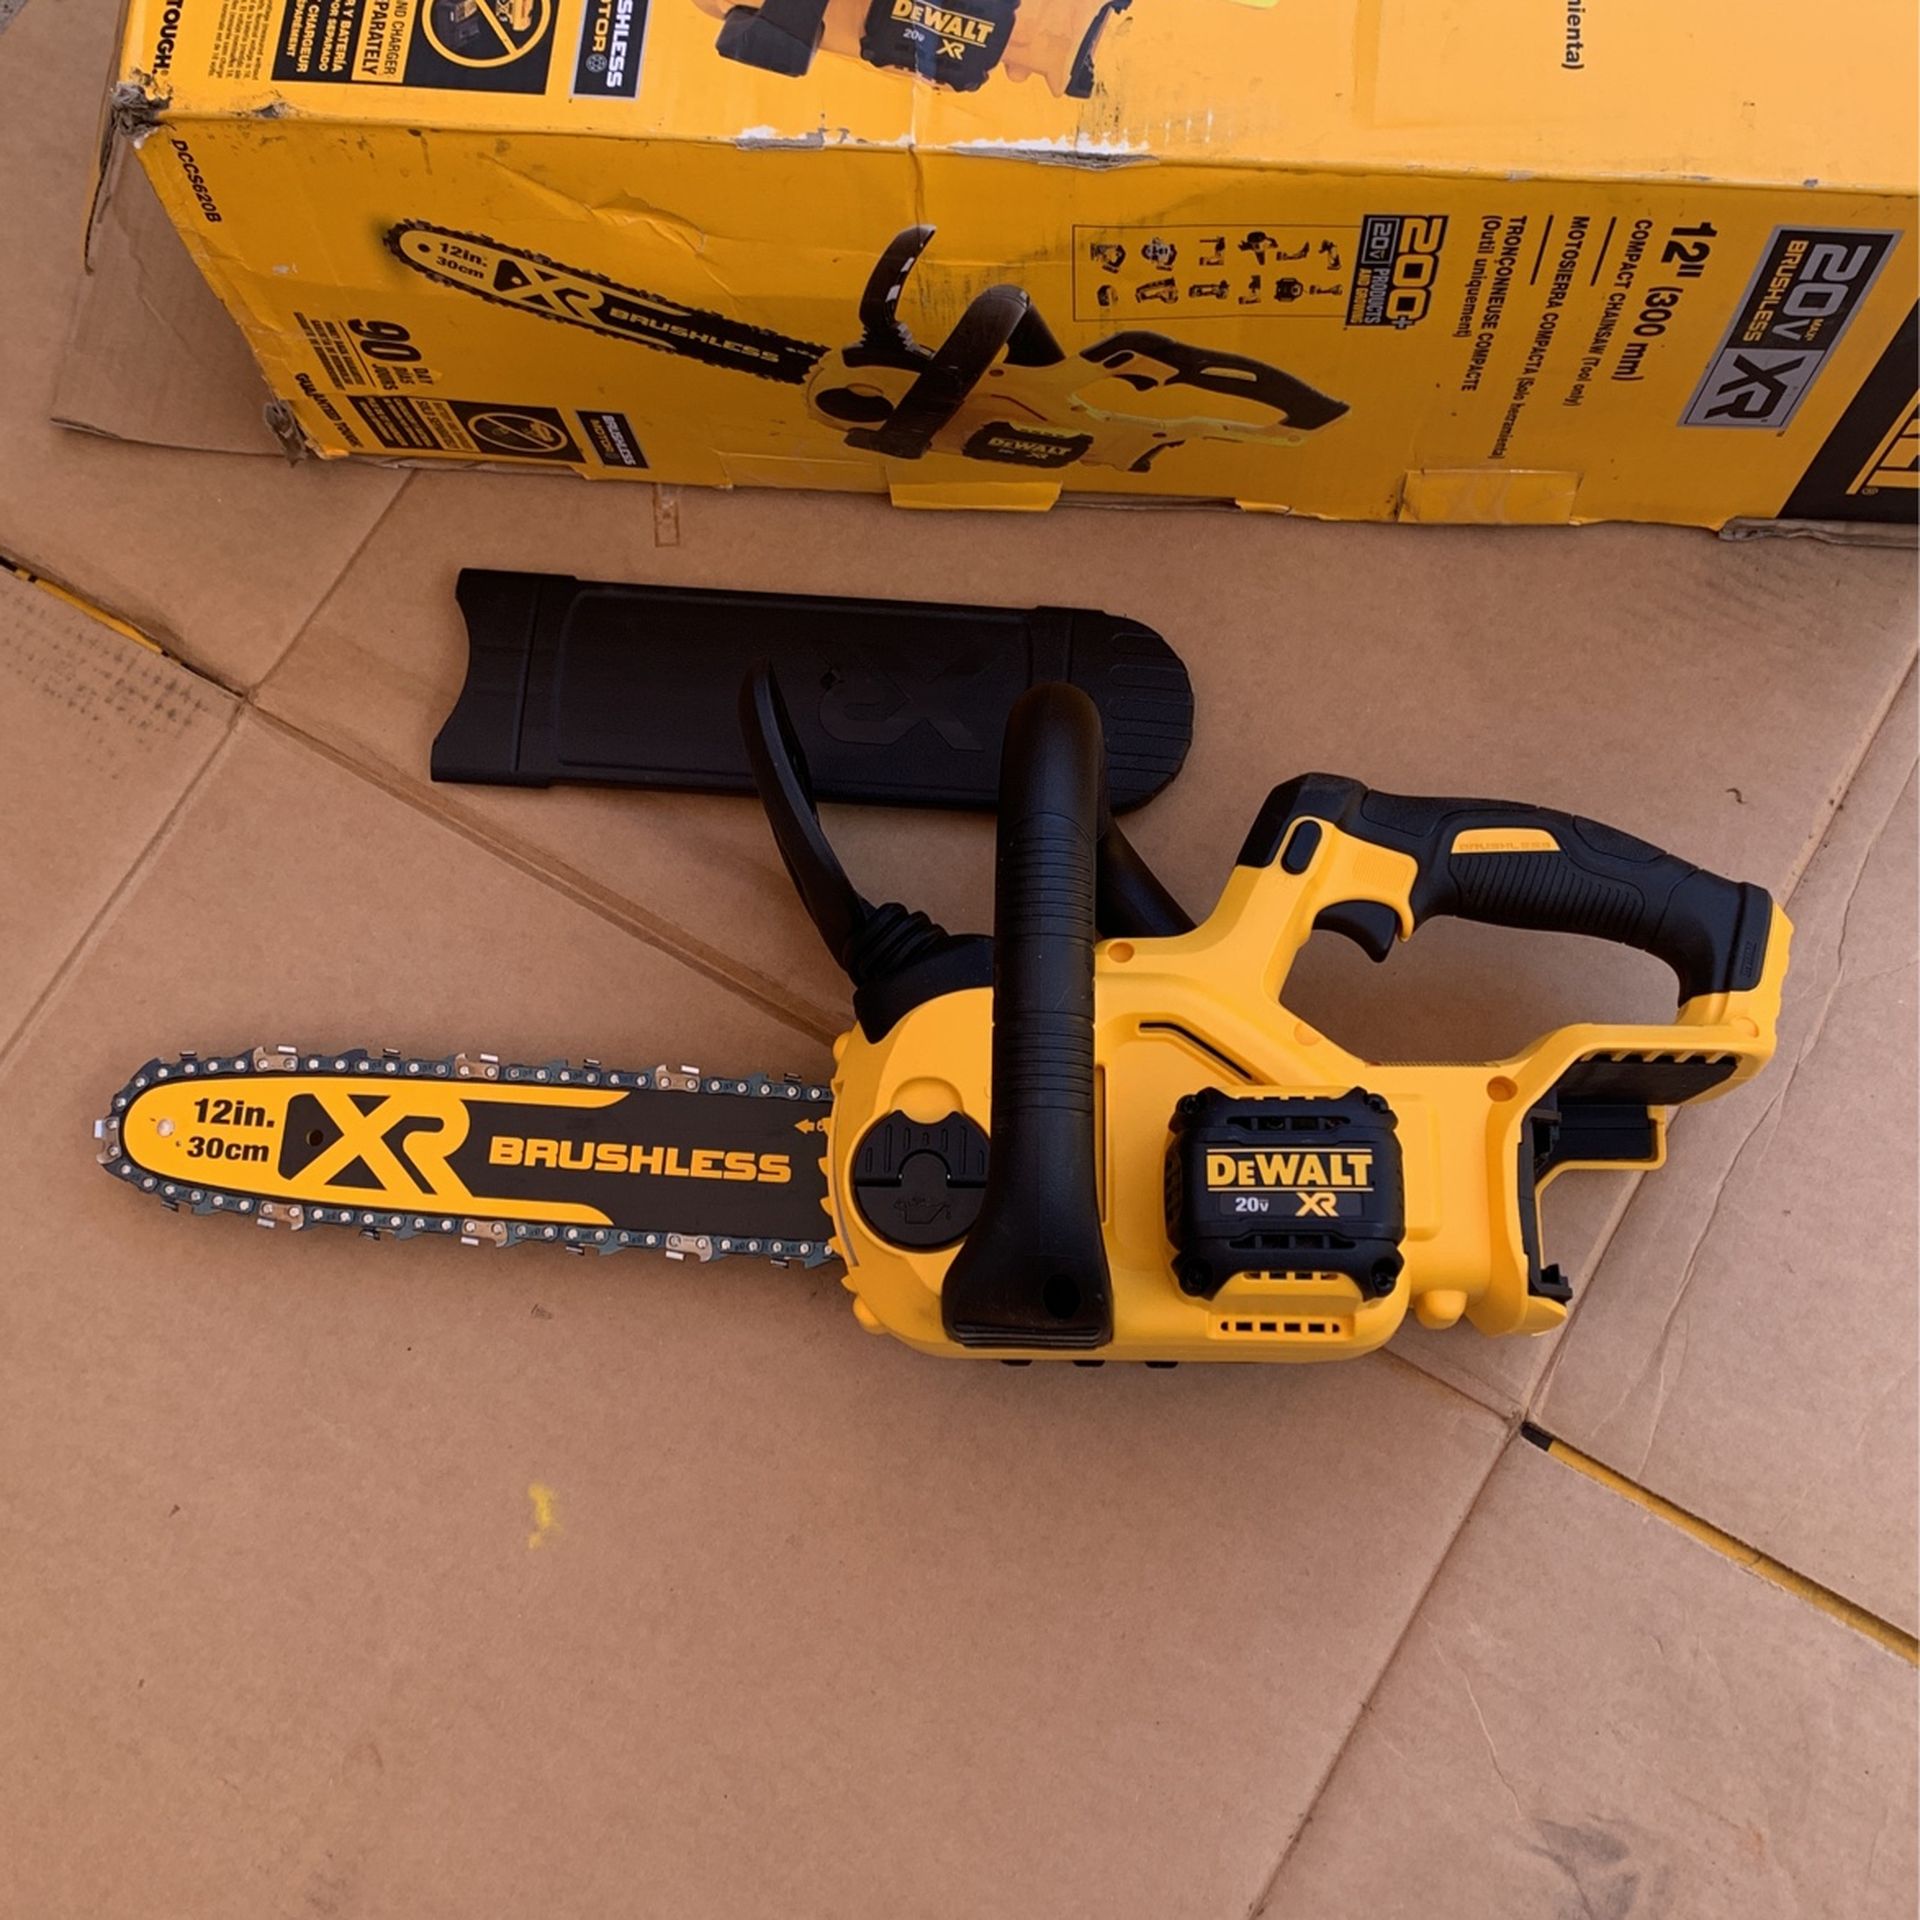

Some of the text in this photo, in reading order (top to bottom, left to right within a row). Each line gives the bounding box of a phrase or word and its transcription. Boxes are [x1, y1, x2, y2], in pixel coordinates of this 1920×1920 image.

[296, 4, 320, 73] CHARGEUR
[343, 9, 354, 18] Y
[892, 0, 994, 44] DEWALT
[318, 18, 337, 71] SEPARADO
[332, 20, 352, 73] BATERÍA
[384, 21, 404, 75] CHARGER
[936, 38, 966, 60] XR
[171, 139, 222, 222] DCCS620B
[436, 256, 485, 279] 30cm
[439, 242, 488, 268] 12in.
[1385, 217, 1446, 329] 200+
[1452, 216, 1503, 338] (Outil uniquement)
[1546, 216, 1590, 309] MOTOSIERRA
[1614, 220, 1652, 289] COMPACT
[1365, 268, 1390, 324] PRODUCTS
[1461, 215, 1527, 391] TRONÇONNEUSE COMPACTE
[1633, 286, 1683, 337] (300
[1743, 240, 1809, 342] BRUSHLESS
[347, 318, 422, 362] 90
[609, 307, 780, 363] BRUSHLESS
[1522, 312, 1559, 375] COMPACTA
[1589, 293, 1626, 355] CHAINSAW
[1577, 357, 1600, 381] (Tool
[1611, 343, 1648, 381] mm)
[1704, 354, 1806, 419] XR
[590, 419, 614, 453] MOTOR
[602, 415, 636, 465] BRUSHLESS
[988, 437, 1072, 455] DEWALT
[193, 1097, 276, 1128] 12in.
[186, 1136, 270, 1162] 30cm
[288, 1091, 472, 1197] XR
[488, 1136, 792, 1184] BRUSHLESS
[1206, 1154, 1373, 1186] DEWALT
[1295, 1192, 1339, 1217] XR
